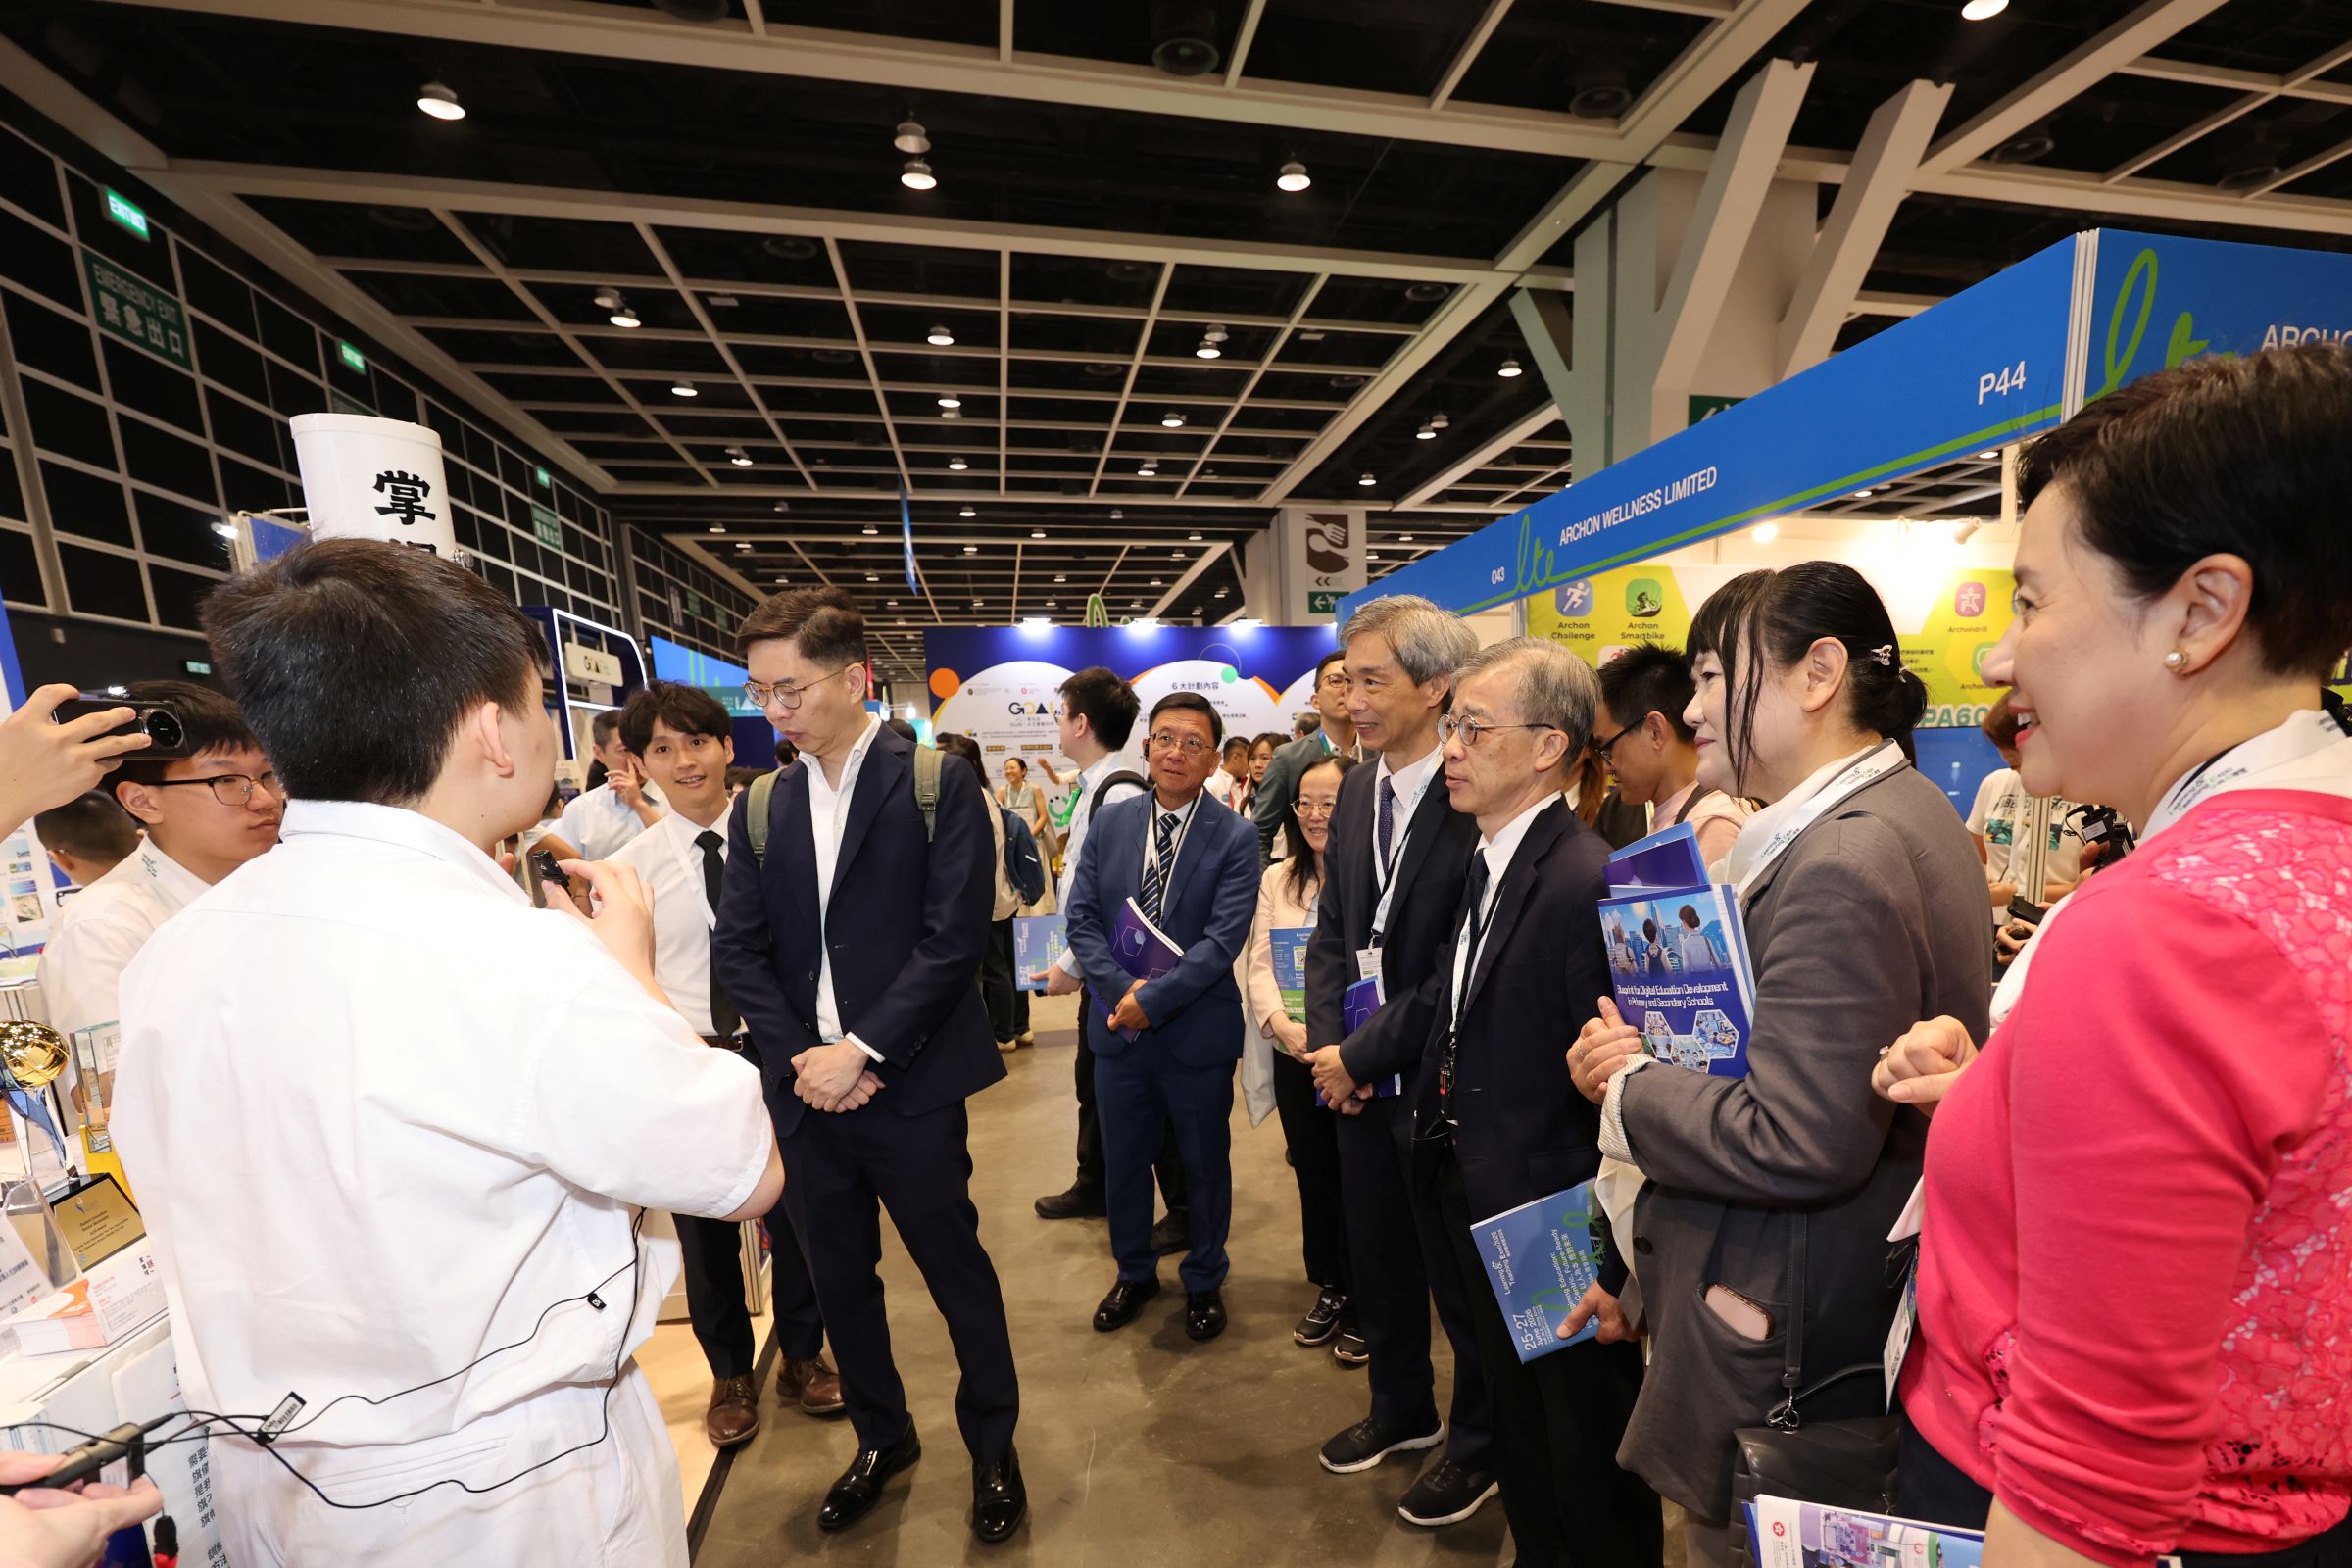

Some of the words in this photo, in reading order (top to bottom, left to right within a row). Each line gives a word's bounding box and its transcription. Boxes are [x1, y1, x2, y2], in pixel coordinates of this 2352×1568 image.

[93, 263, 156, 313] EMERGENCY
[157, 298, 178, 326] EXIT
[99, 289, 184, 359] 緊急出口
[2105, 248, 2238, 389] lt
[1978, 360, 2027, 406] P44
[373, 470, 438, 554] 掌
[1559, 514, 1600, 546] ARCHON
[1602, 489, 1662, 528] WELLNESS
[1664, 466, 1718, 505] LIMITED
[1551, 631, 1596, 641] Challenge
[1620, 631, 1665, 641] Smartbike
[1641, 984, 1655, 997] Digital
[1655, 984, 1684, 996] Education
[1684, 981, 1729, 995] Development
[1656, 996, 1687, 1009] Secondary
[1687, 995, 1714, 1006] Schools
[1549, 1228, 1572, 1274] Future-Ready
[1498, 1269, 1511, 1296] Learning
[1502, 1259, 1516, 1286] Teaching
[1549, 1251, 1567, 1288] Education:
[1571, 1262, 1588, 1290] 以人為本
[1562, 1288, 1577, 1312] gining
[1524, 1308, 1537, 1327] 2026
[1512, 1312, 1537, 1351] 25-27
[1532, 1327, 1544, 1348] June
[188, 1445, 209, 1469] 需要
